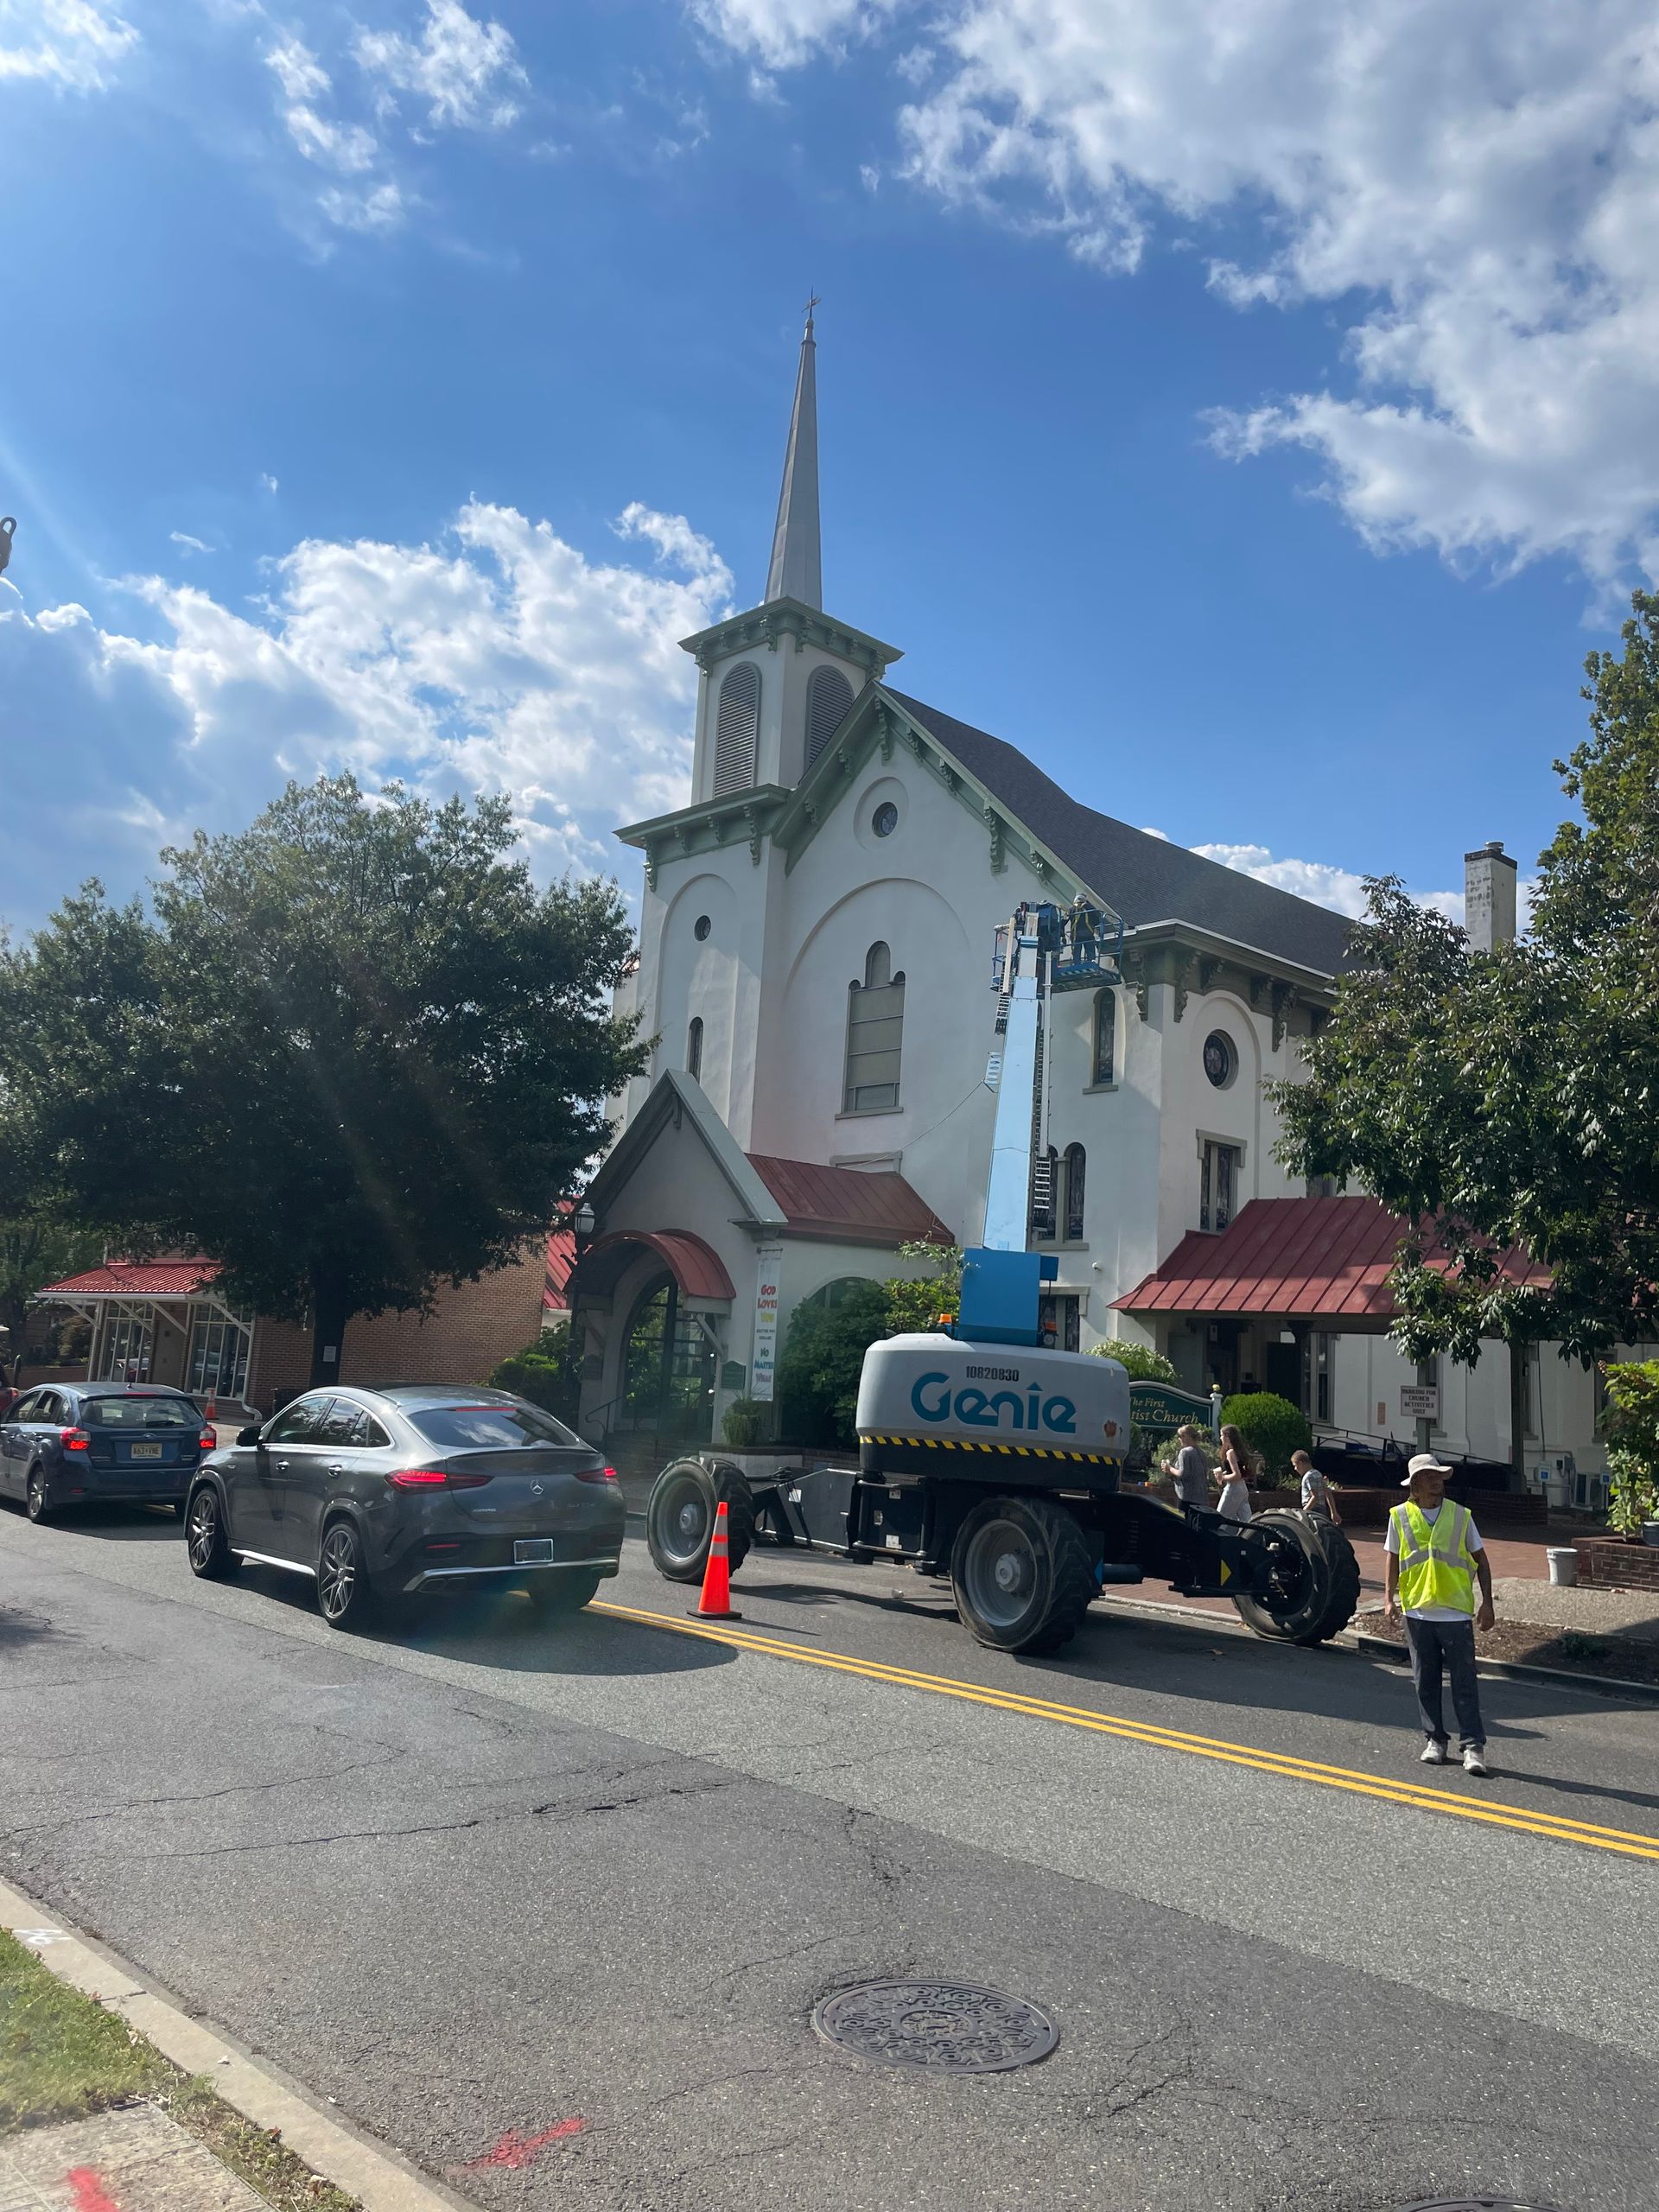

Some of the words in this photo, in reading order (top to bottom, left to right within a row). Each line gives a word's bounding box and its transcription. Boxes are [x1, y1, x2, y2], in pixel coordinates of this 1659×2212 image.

[760, 1284, 776, 1295] GOD
[966, 1366, 1020, 1382] 10820830
[911, 1371, 1077, 1434] Genie
[1145, 1397, 1165, 1408] First
[1131, 1409, 1150, 1421] tist
[1153, 1409, 1198, 1424] Church
